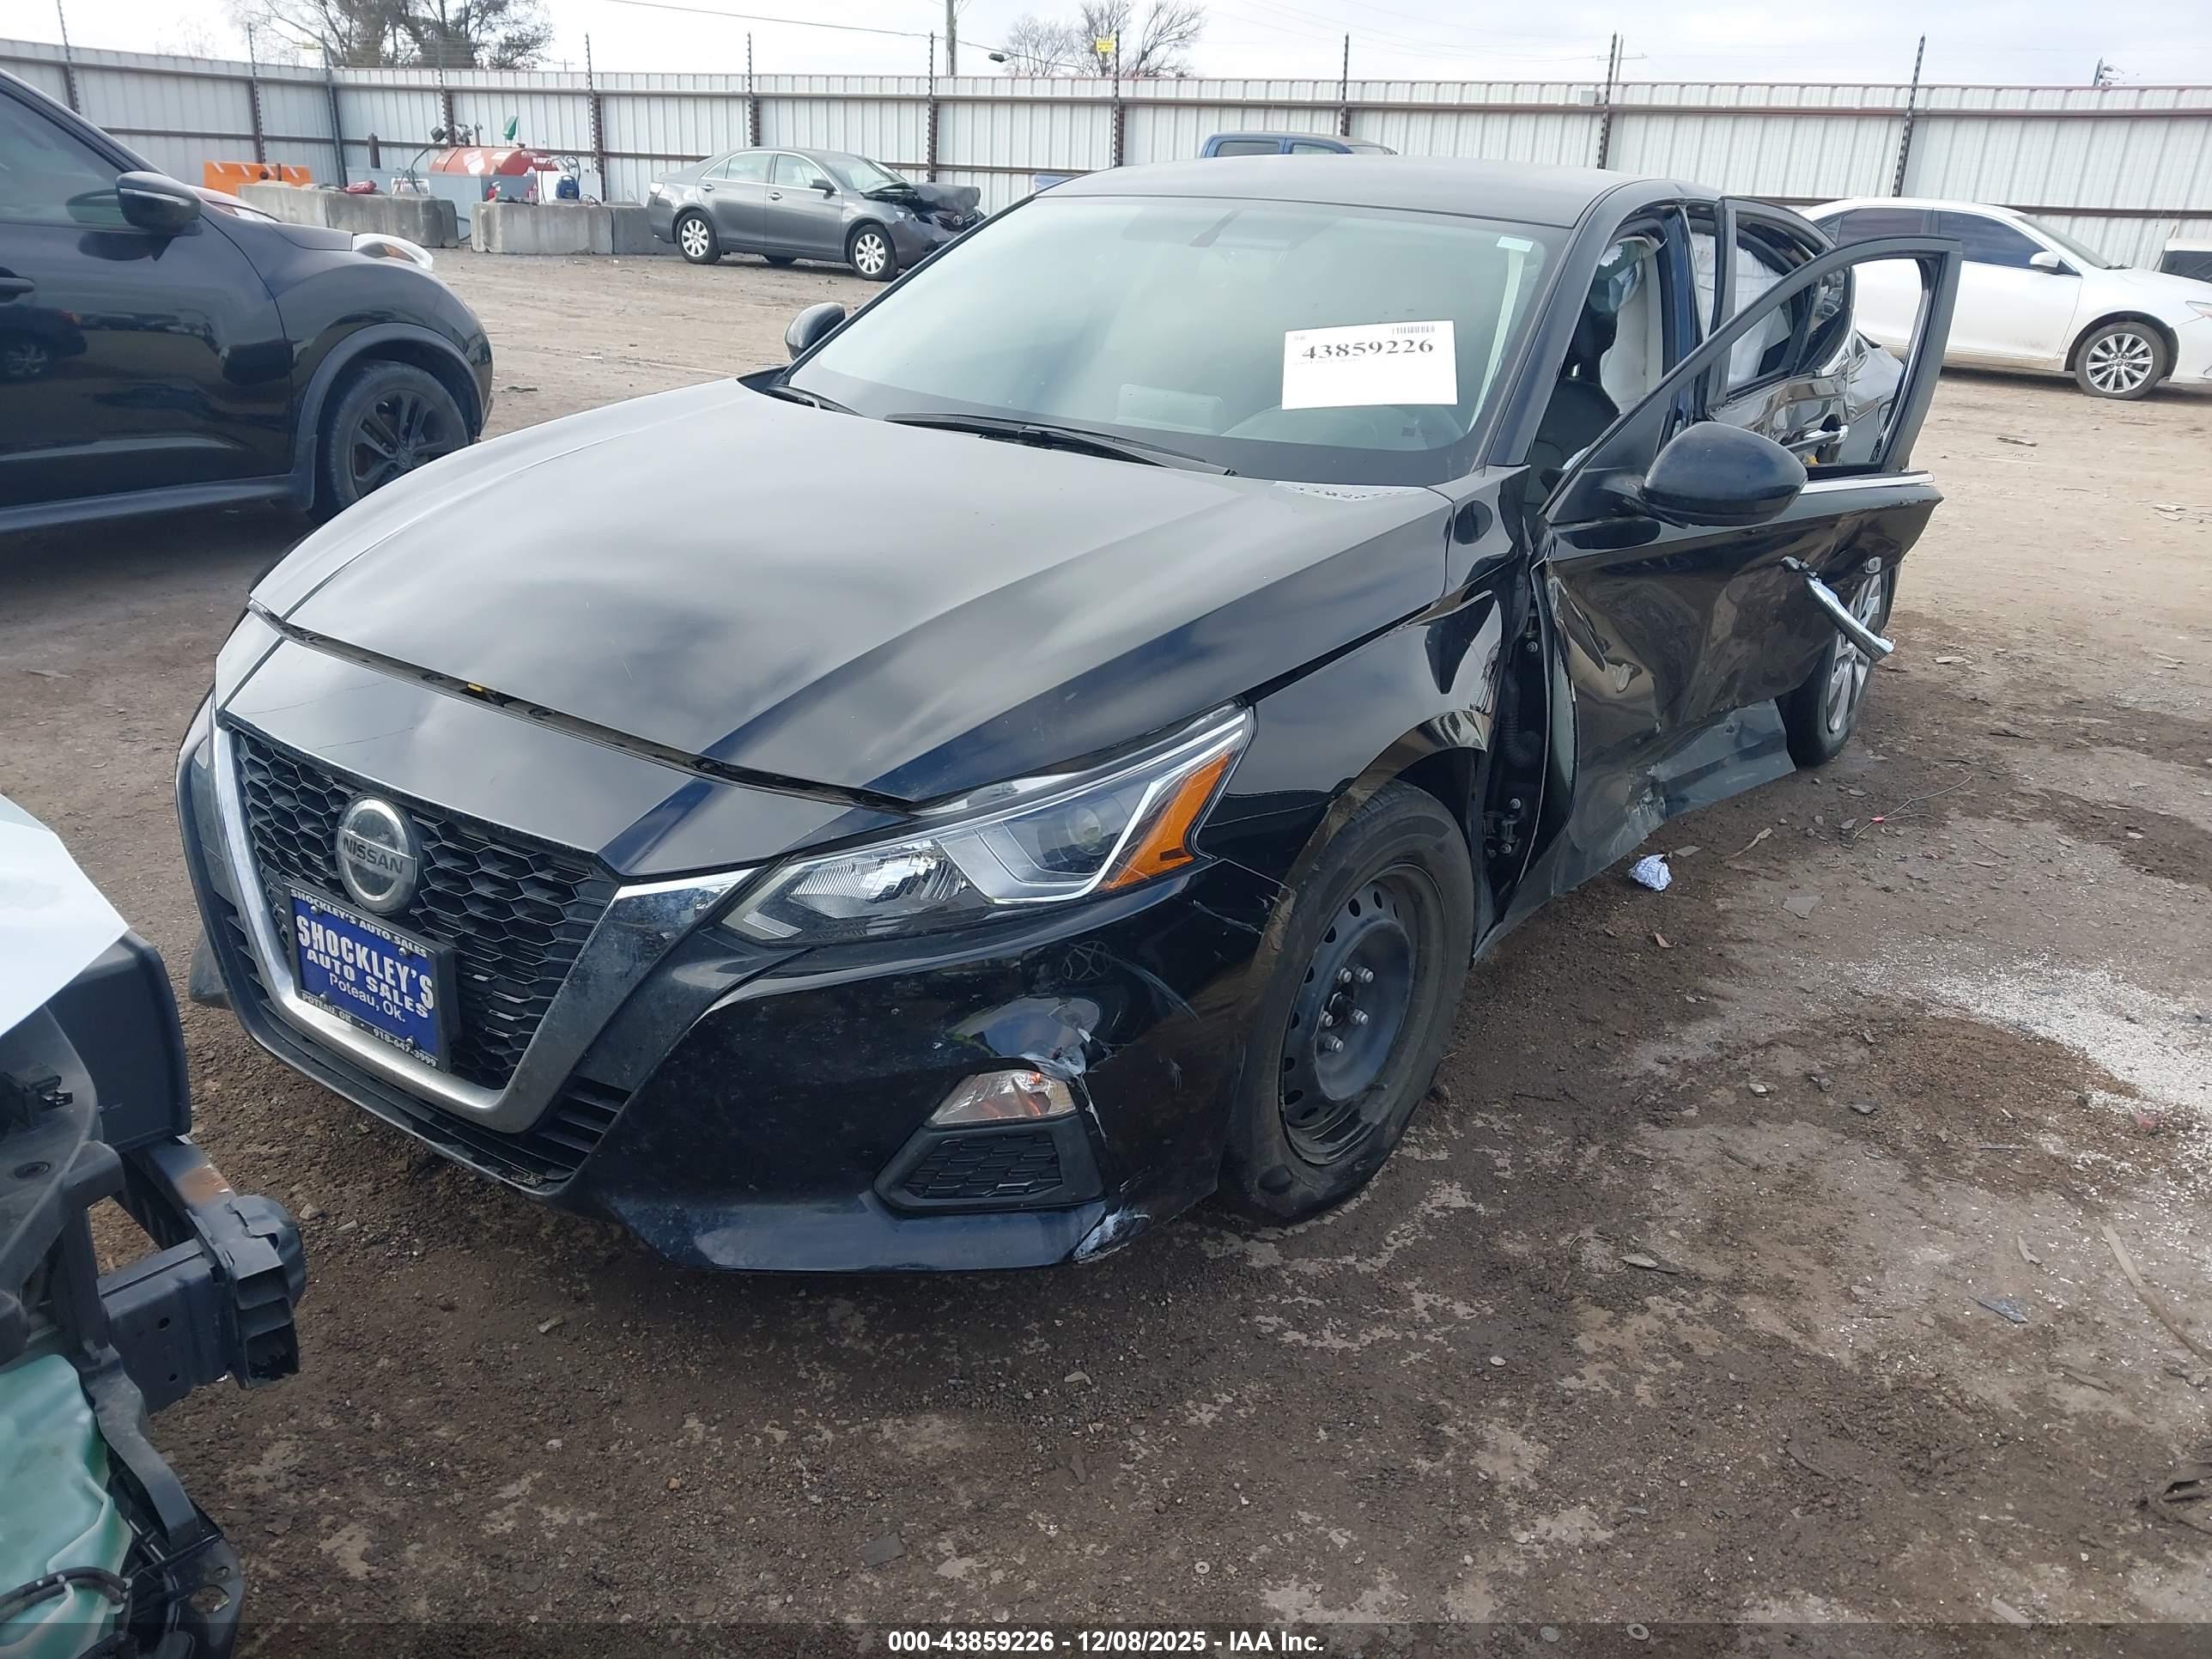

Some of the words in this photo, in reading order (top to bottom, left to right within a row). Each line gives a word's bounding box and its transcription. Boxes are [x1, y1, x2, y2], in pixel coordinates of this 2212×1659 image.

[1302, 338, 1434, 360] 43859226
[343, 836, 404, 874] NISSAN
[290, 888, 357, 925] SHOCKLEY'S
[358, 920, 391, 940] AUTO
[393, 936, 428, 958] SALES
[295, 915, 434, 1010] SHOCKLEY'S
[307, 949, 356, 981] AUTO
[365, 975, 428, 1018] SALES
[329, 972, 380, 1012] Poteau,
[382, 1000, 406, 1023] Ok.
[338, 1009, 352, 1023] OK
[373, 1028, 437, 1067] 918-647-3999
